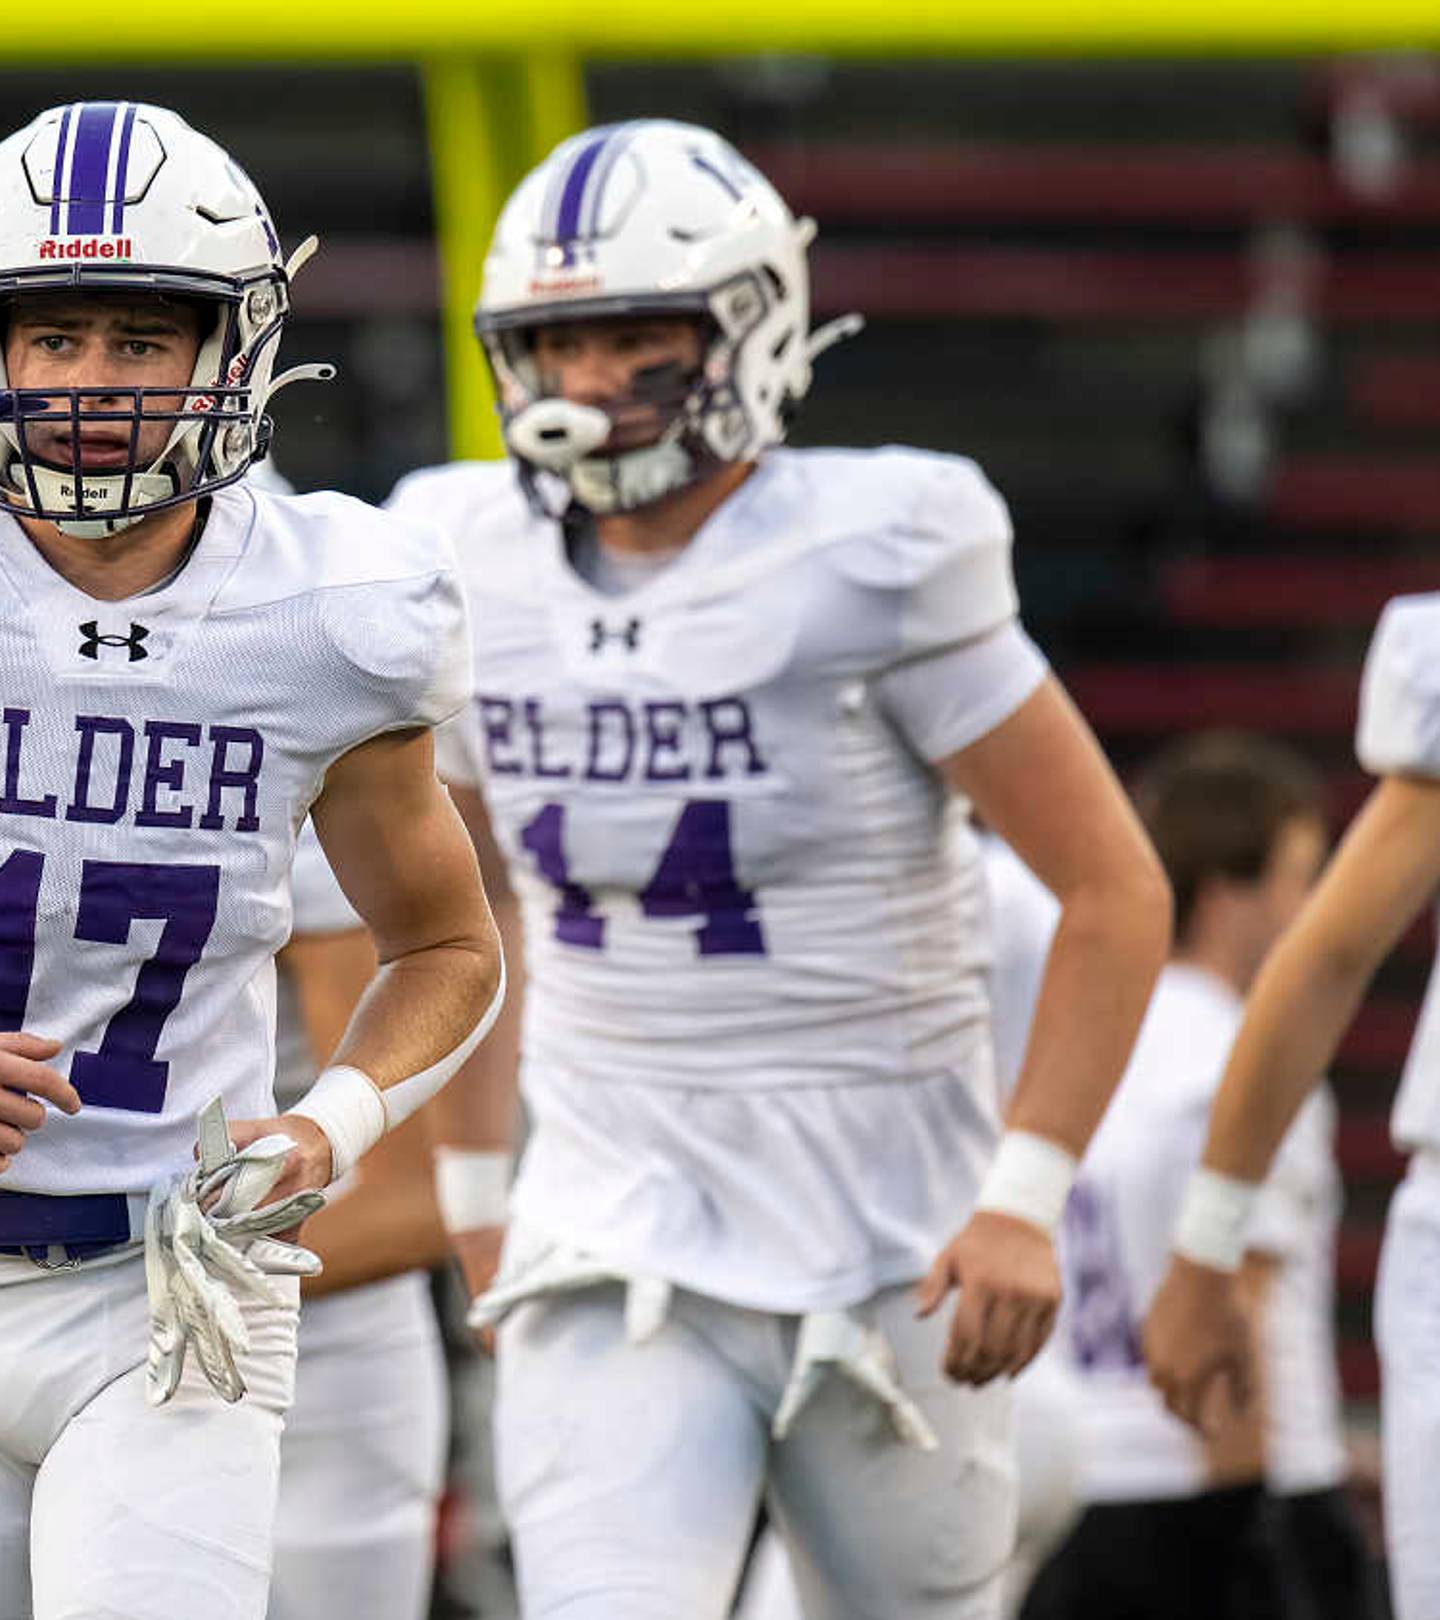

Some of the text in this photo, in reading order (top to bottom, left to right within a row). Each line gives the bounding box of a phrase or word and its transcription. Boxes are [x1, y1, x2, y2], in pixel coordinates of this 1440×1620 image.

[40, 238, 131, 259] Riddell
[60, 484, 108, 499] Ridell
[475, 696, 767, 781] ELDER
[520, 799, 767, 955] 14
